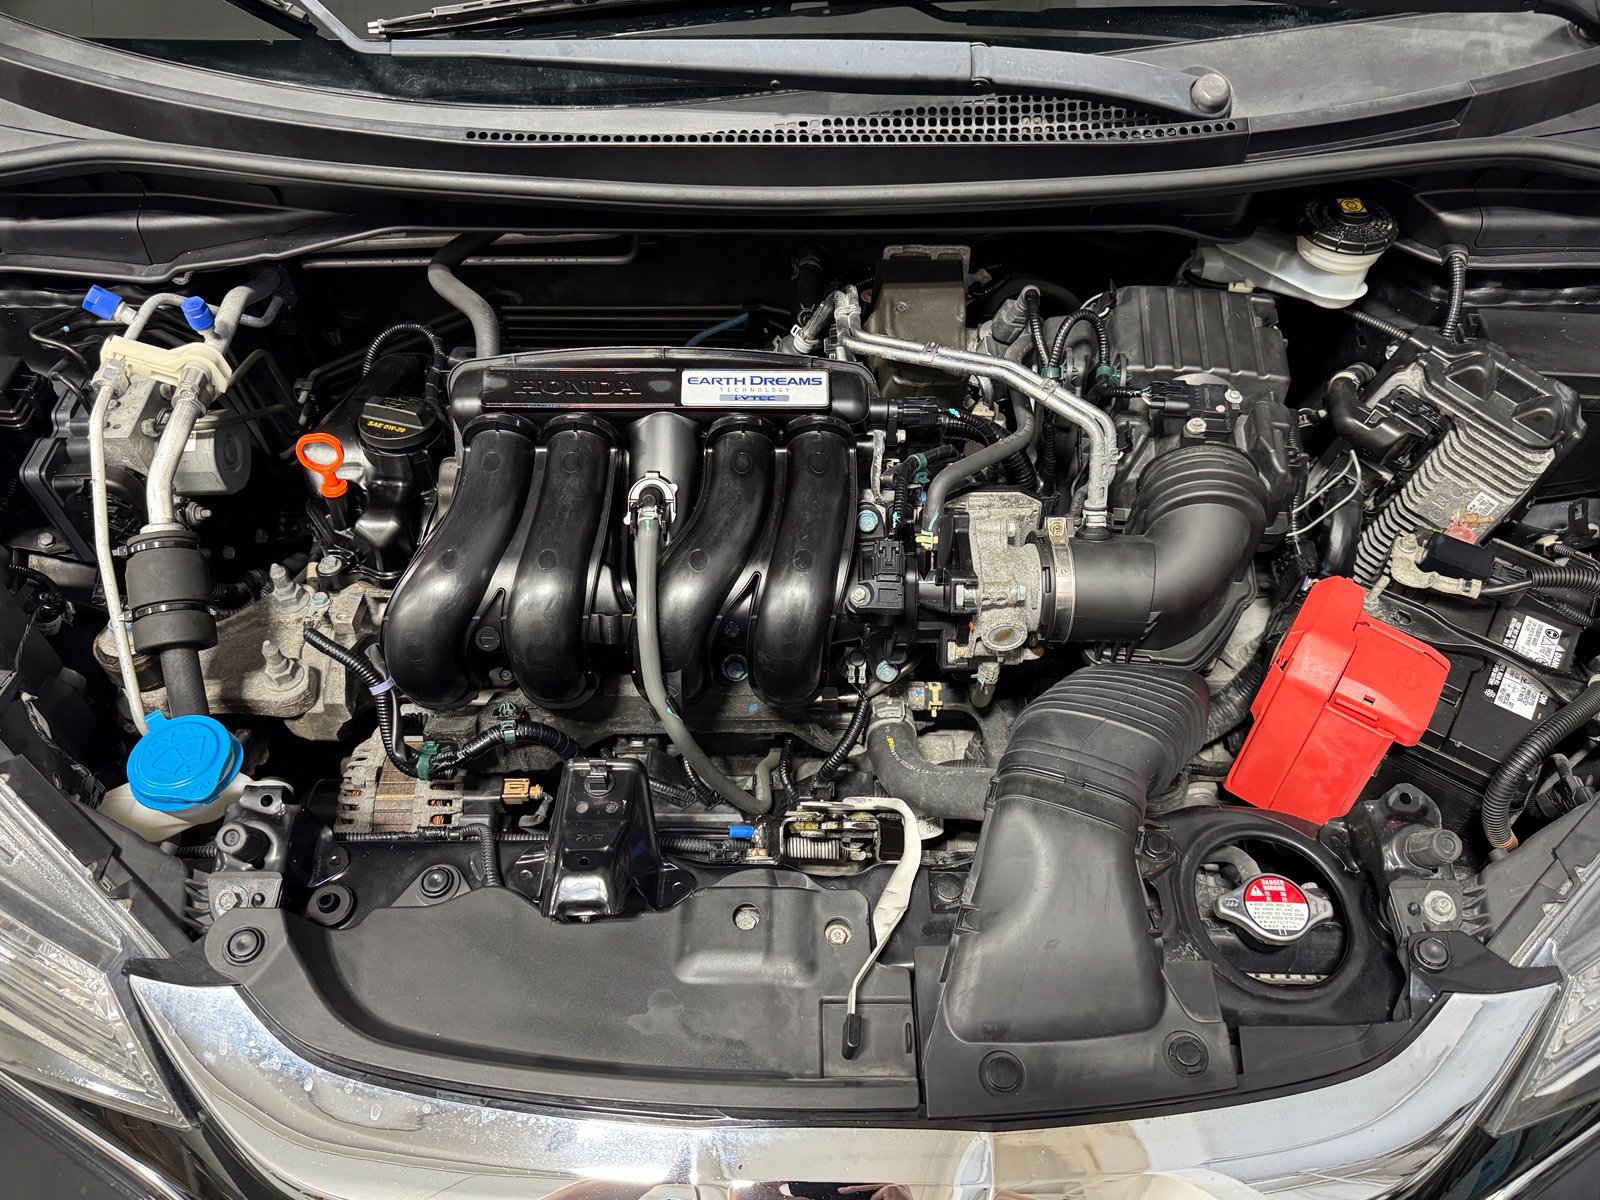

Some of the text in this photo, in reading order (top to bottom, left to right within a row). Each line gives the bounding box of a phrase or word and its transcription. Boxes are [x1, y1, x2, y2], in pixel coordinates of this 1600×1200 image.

[687, 375, 823, 386] EARTH DREAMS
[514, 380, 642, 396] HONDA
[367, 421, 406, 433] SAE 0W-20
